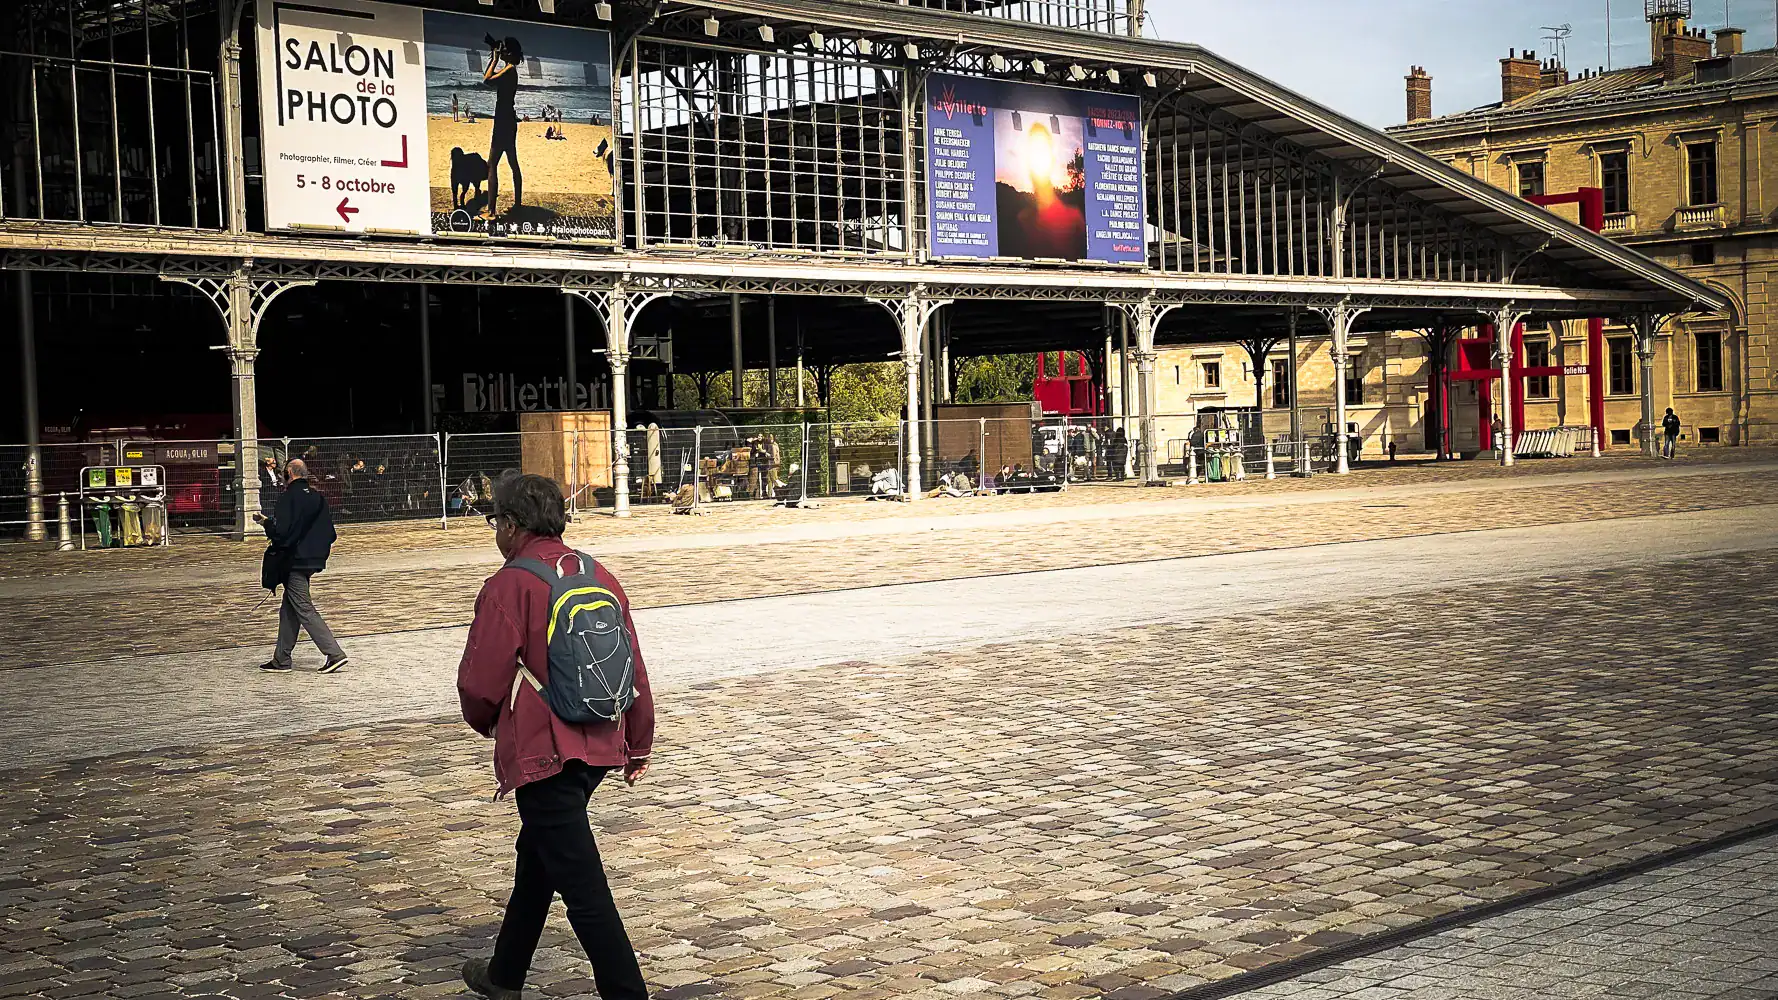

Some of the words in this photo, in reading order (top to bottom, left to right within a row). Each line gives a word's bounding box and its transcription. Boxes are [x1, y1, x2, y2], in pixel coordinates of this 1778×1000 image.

[285, 38, 394, 79] SALON
[357, 78, 376, 94] de
[381, 80, 395, 96] la
[288, 89, 397, 128] PHOTO
[934, 136, 940, 144] DE
[279, 152, 332, 164] Photographier,
[333, 156, 356, 166] Filmer,
[358, 157, 377, 167] Créer
[935, 170, 954, 179] PHILIPPE
[1119, 164, 1124, 172] DU
[296, 174, 306, 189] 5
[321, 175, 331, 190] 8
[336, 178, 396, 194] octobre
[551, 226, 610, 236] #salonphotoparis
[463, 372, 611, 412] Billetteri
[166, 449, 187, 458] ACQUA
[192, 449, 207, 458] OLIO
